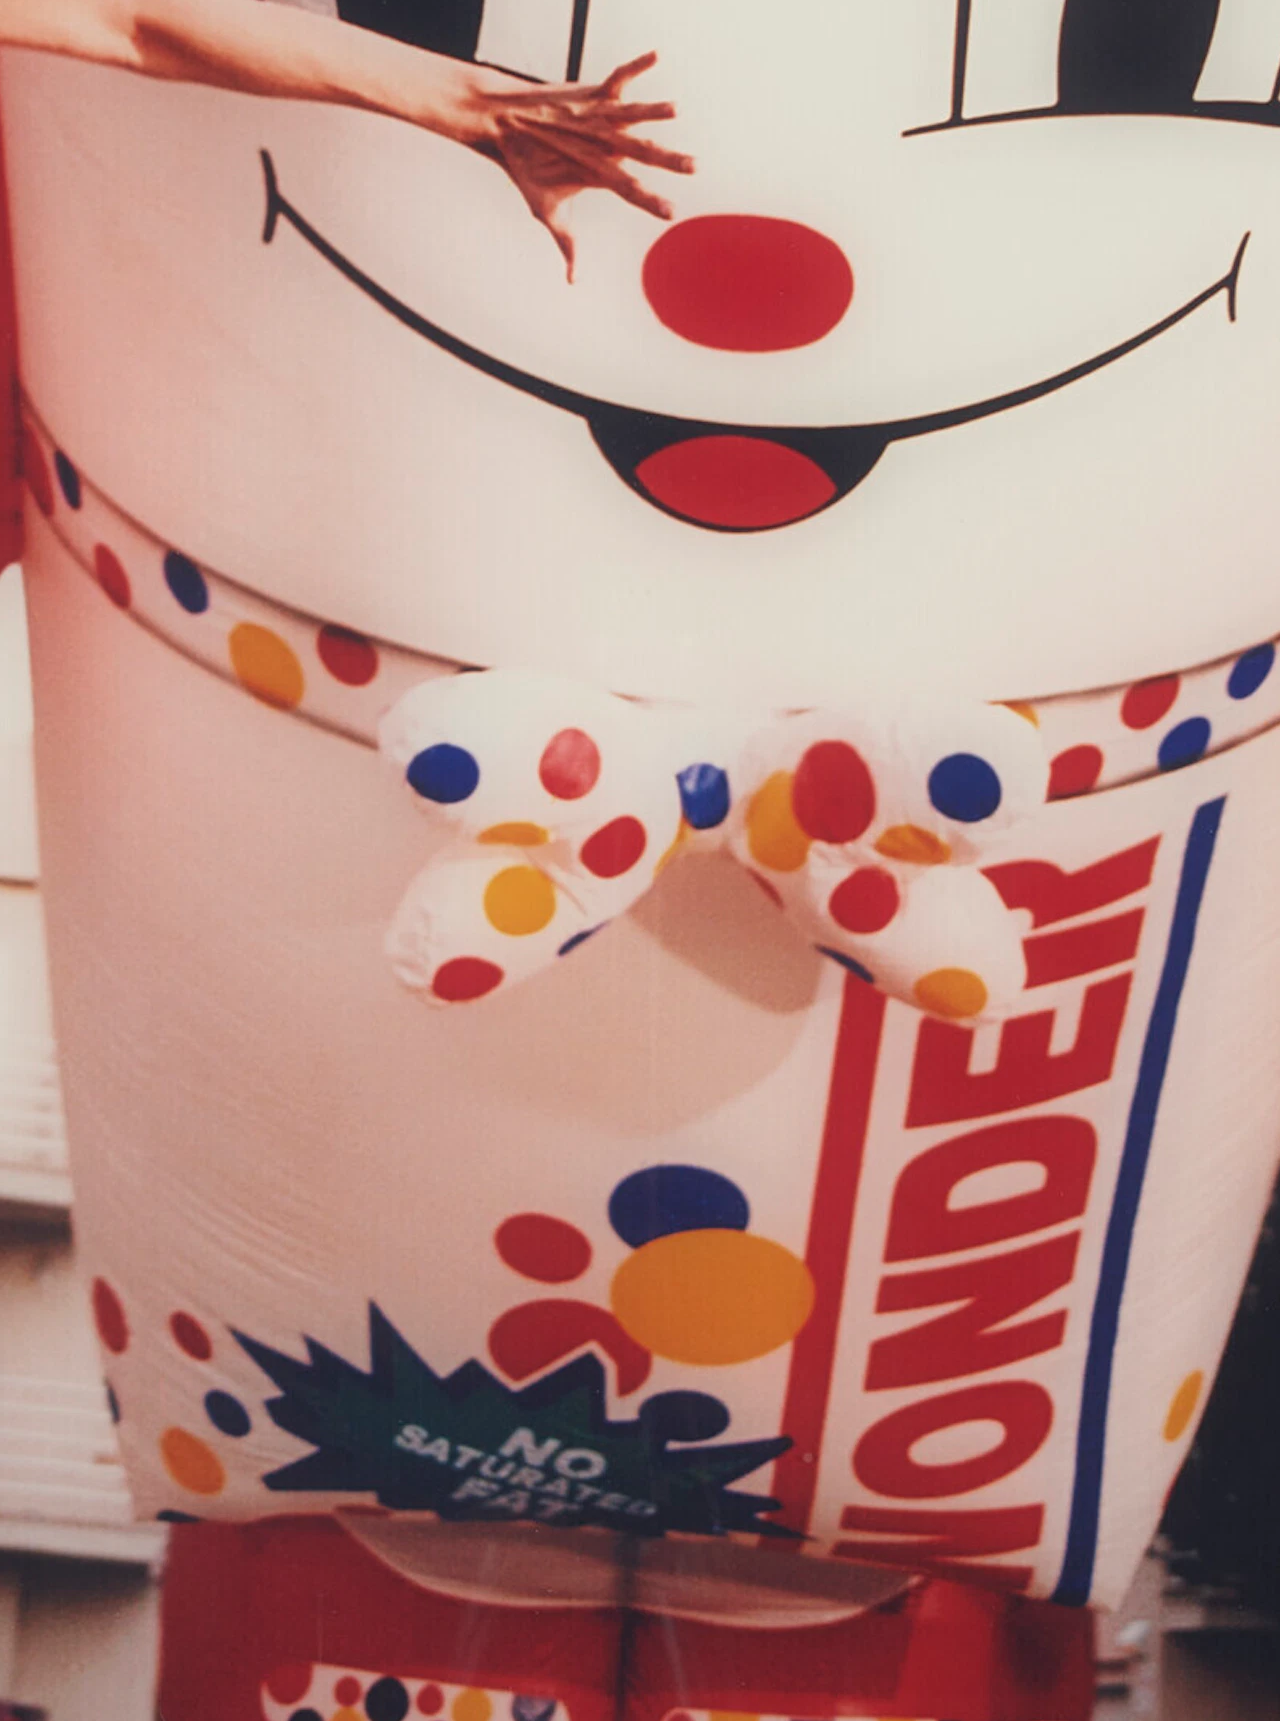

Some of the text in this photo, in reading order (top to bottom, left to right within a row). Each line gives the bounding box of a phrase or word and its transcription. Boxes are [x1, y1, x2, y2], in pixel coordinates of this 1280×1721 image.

[393, 1424, 658, 1517] SATURATED
[498, 1427, 607, 1480] NO
[451, 1476, 584, 1520] FAT
